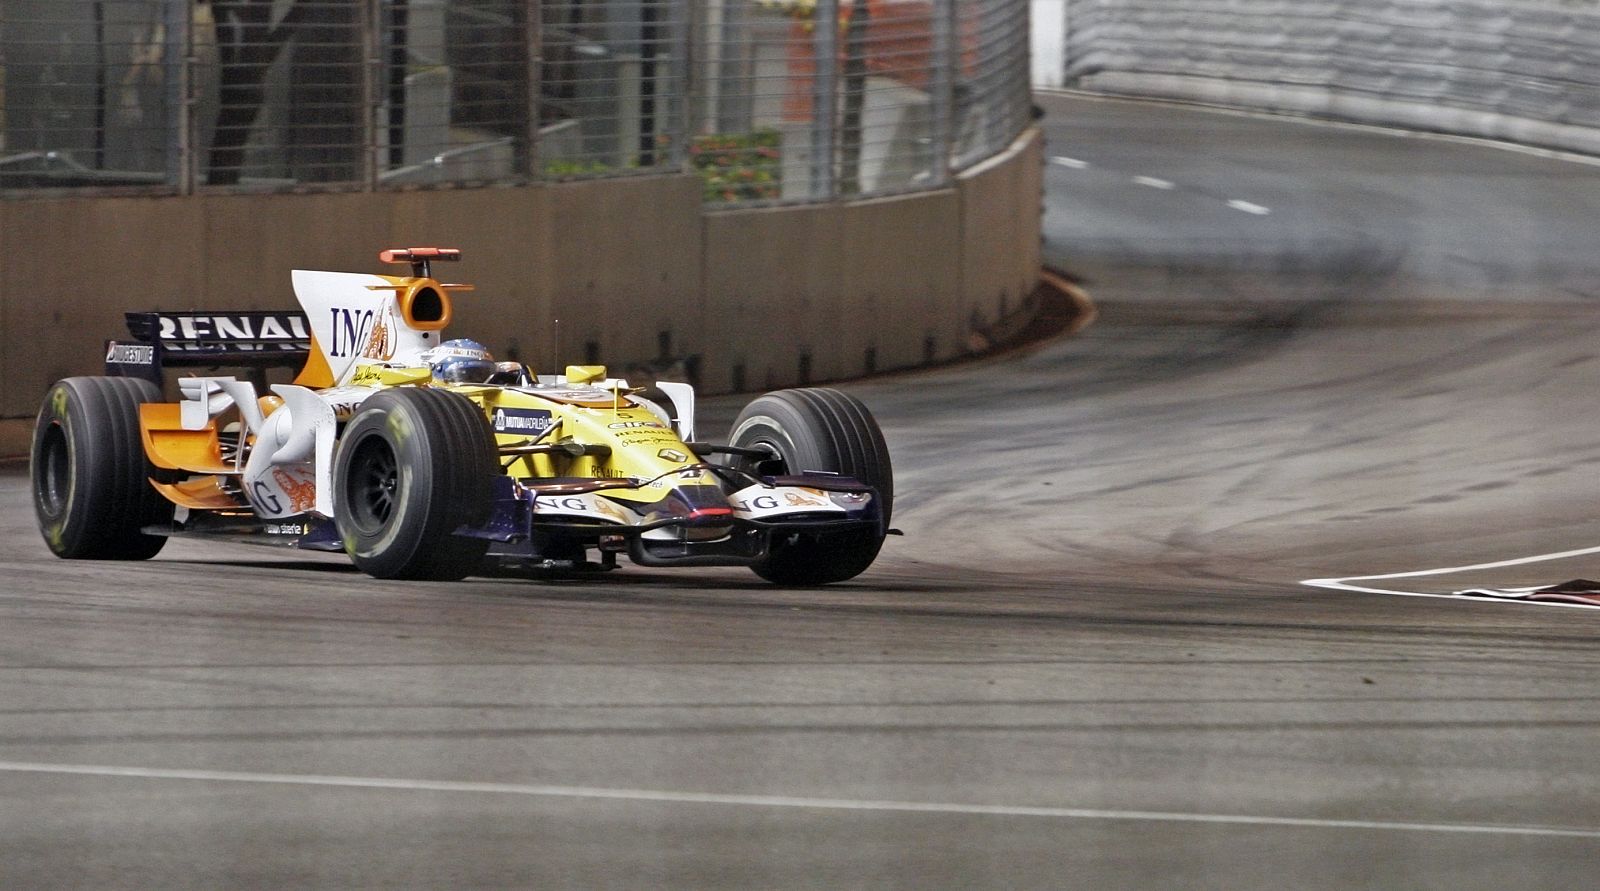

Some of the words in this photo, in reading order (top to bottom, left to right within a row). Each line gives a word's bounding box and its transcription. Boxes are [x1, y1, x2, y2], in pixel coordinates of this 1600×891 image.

[158, 315, 311, 350] RENAU
[330, 308, 373, 358] ING
[535, 498, 587, 511] NG
[733, 496, 778, 512] NG
